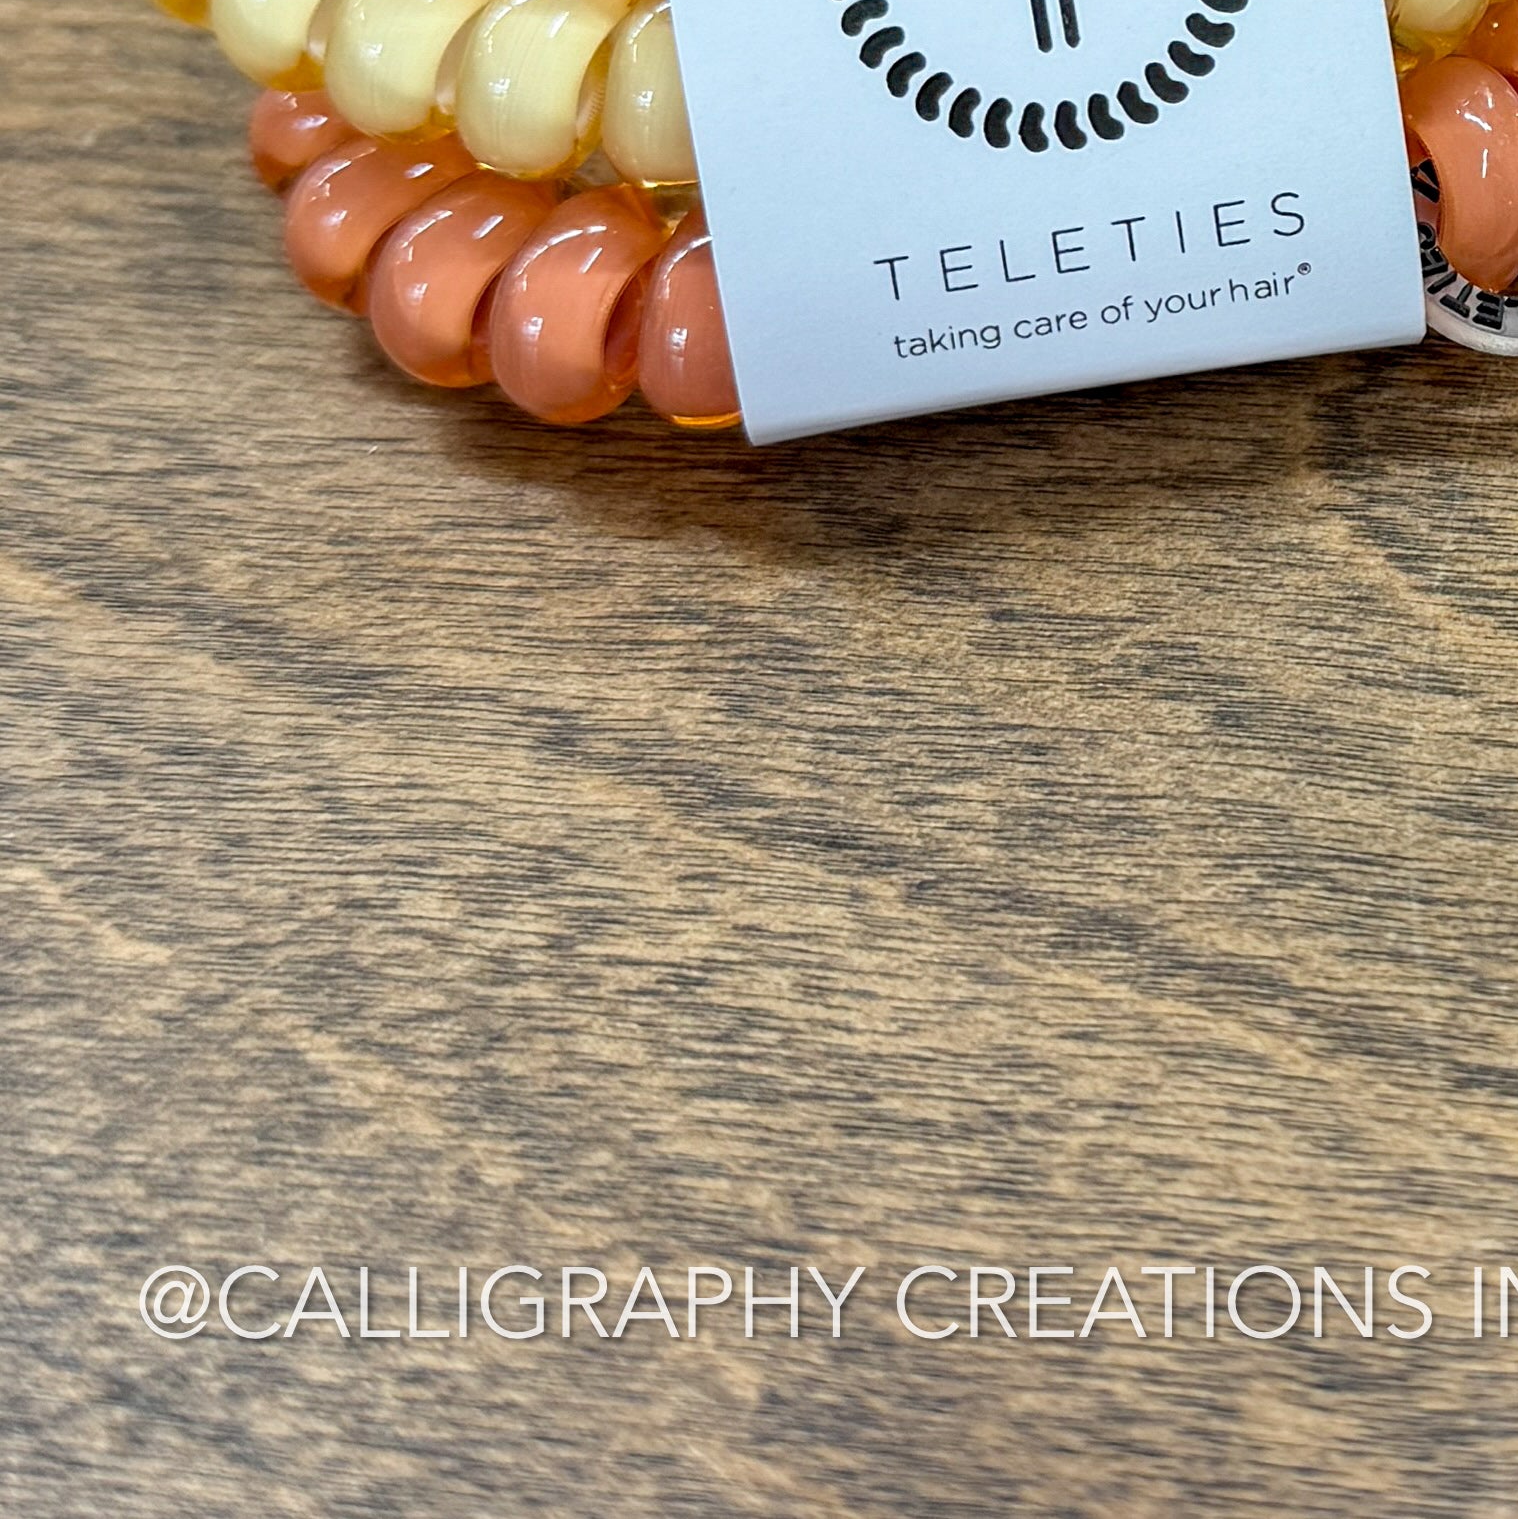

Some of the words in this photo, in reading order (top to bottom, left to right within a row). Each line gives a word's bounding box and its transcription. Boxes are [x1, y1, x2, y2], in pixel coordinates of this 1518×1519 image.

[873, 191, 1306, 301] TELETIES
[892, 324, 1002, 360] taking
[1012, 309, 1089, 339] care
[1099, 294, 1135, 325] of
